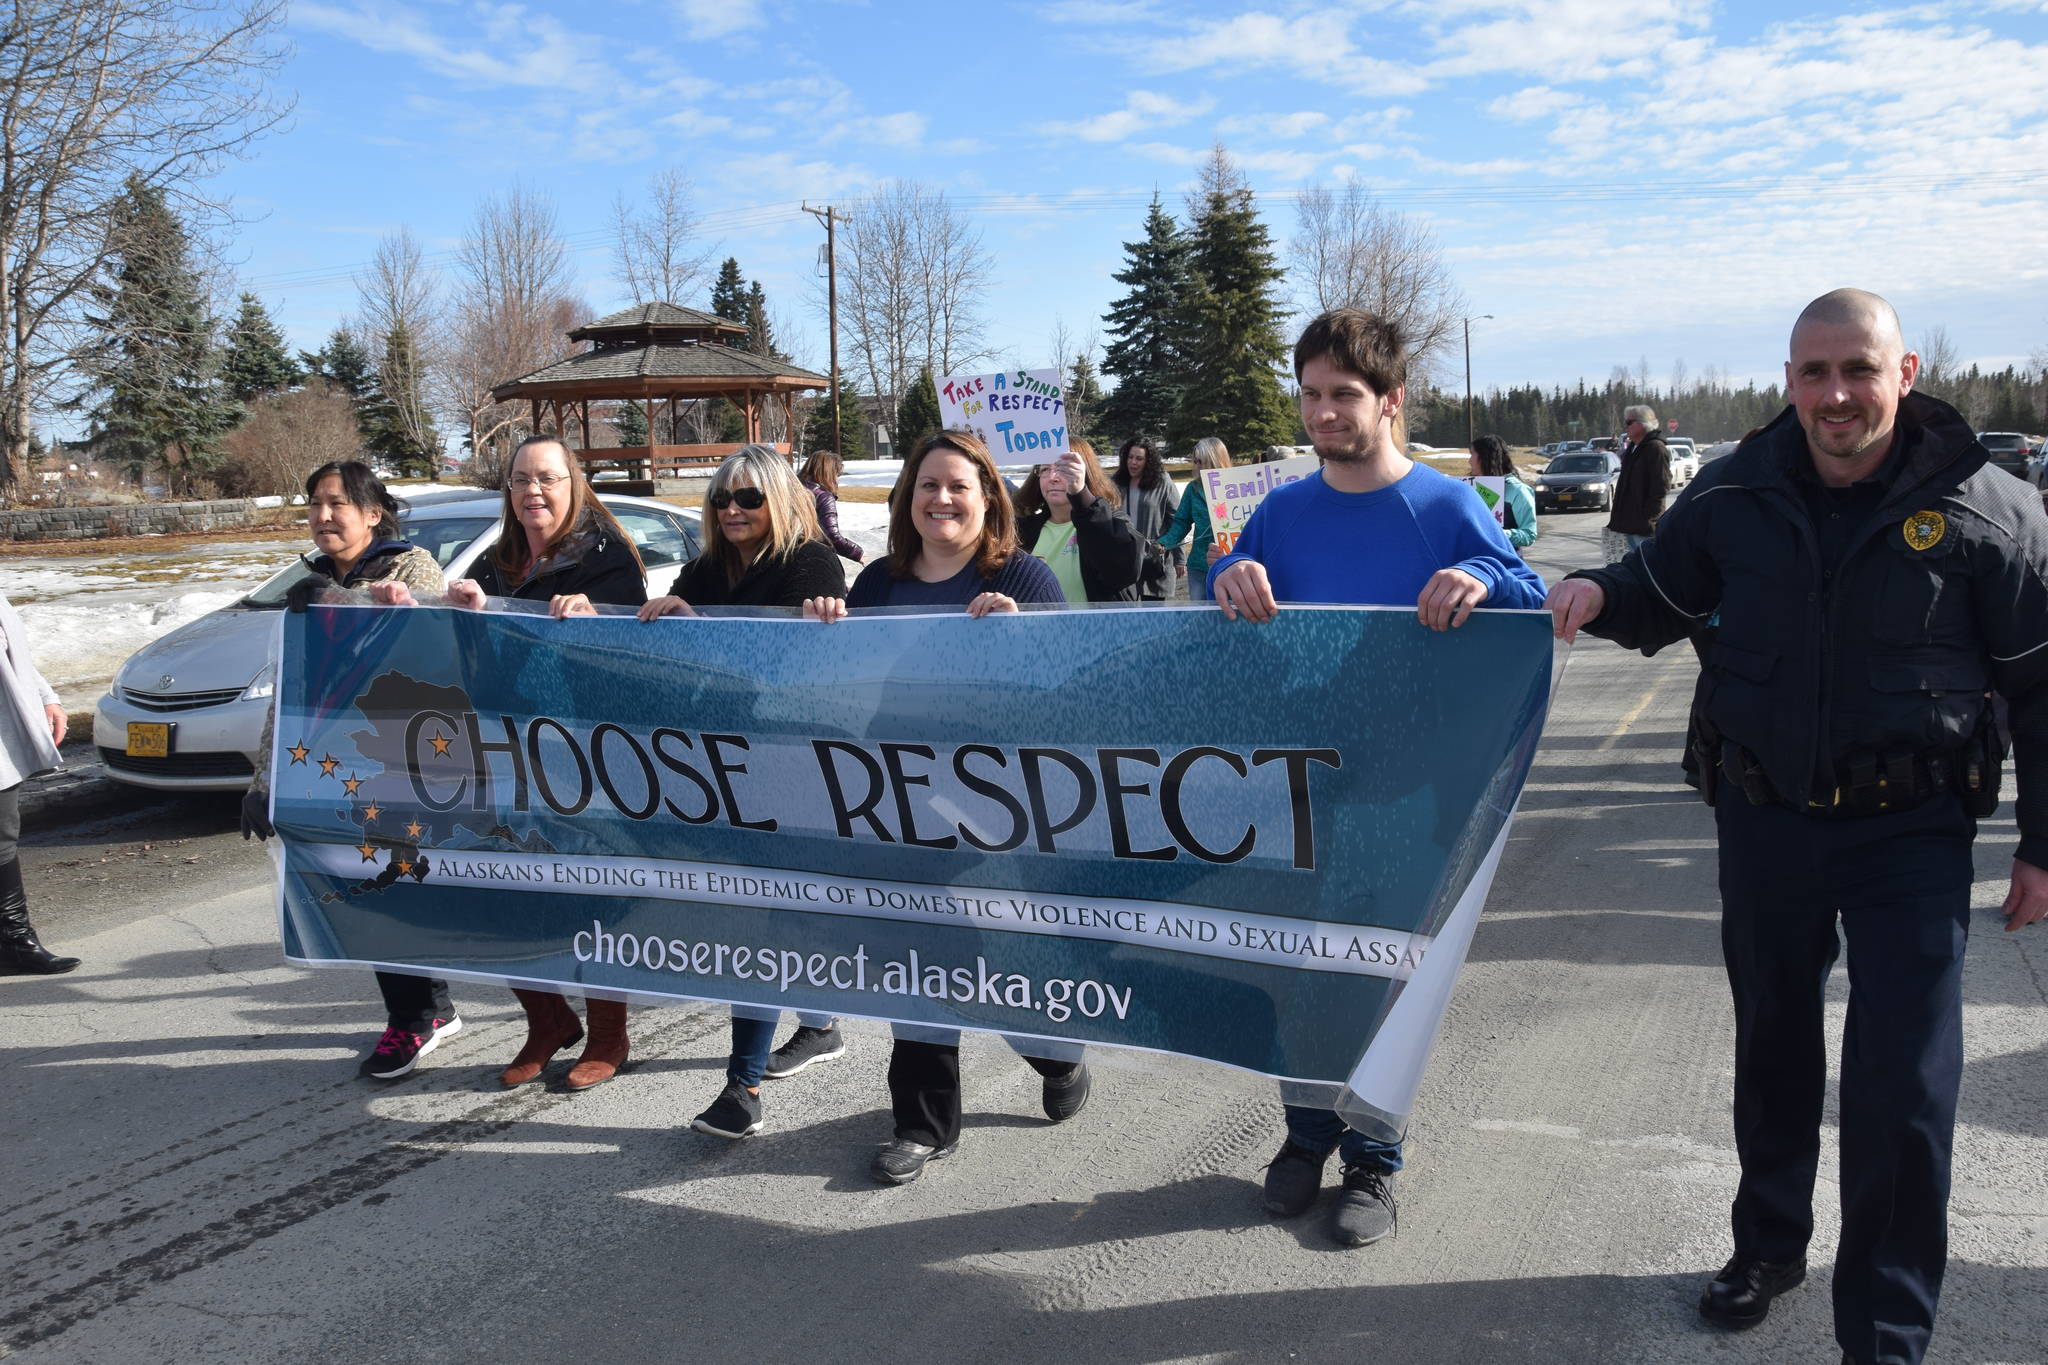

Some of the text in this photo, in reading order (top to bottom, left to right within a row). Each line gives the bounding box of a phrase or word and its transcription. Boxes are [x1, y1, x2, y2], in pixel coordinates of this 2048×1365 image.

[943, 370, 1060, 405] TAKE A STAND
[988, 393, 1064, 415] RESPECT
[995, 420, 1065, 453] TODAY
[403, 710, 1342, 872] CHOOSE RESPECT
[437, 857, 544, 883] ALASKANS
[552, 862, 648, 888] ENDING
[654, 869, 699, 891] THE
[706, 871, 820, 902] EPIDEMIC
[826, 884, 856, 905] OF
[865, 886, 1002, 918] DOMESTIC
[1008, 898, 1147, 932] VIOLENCE
[1154, 916, 1219, 943] AND
[1228, 922, 1336, 959] SEXUAL
[573, 919, 1132, 1021] chooserespect.alaska.gov
